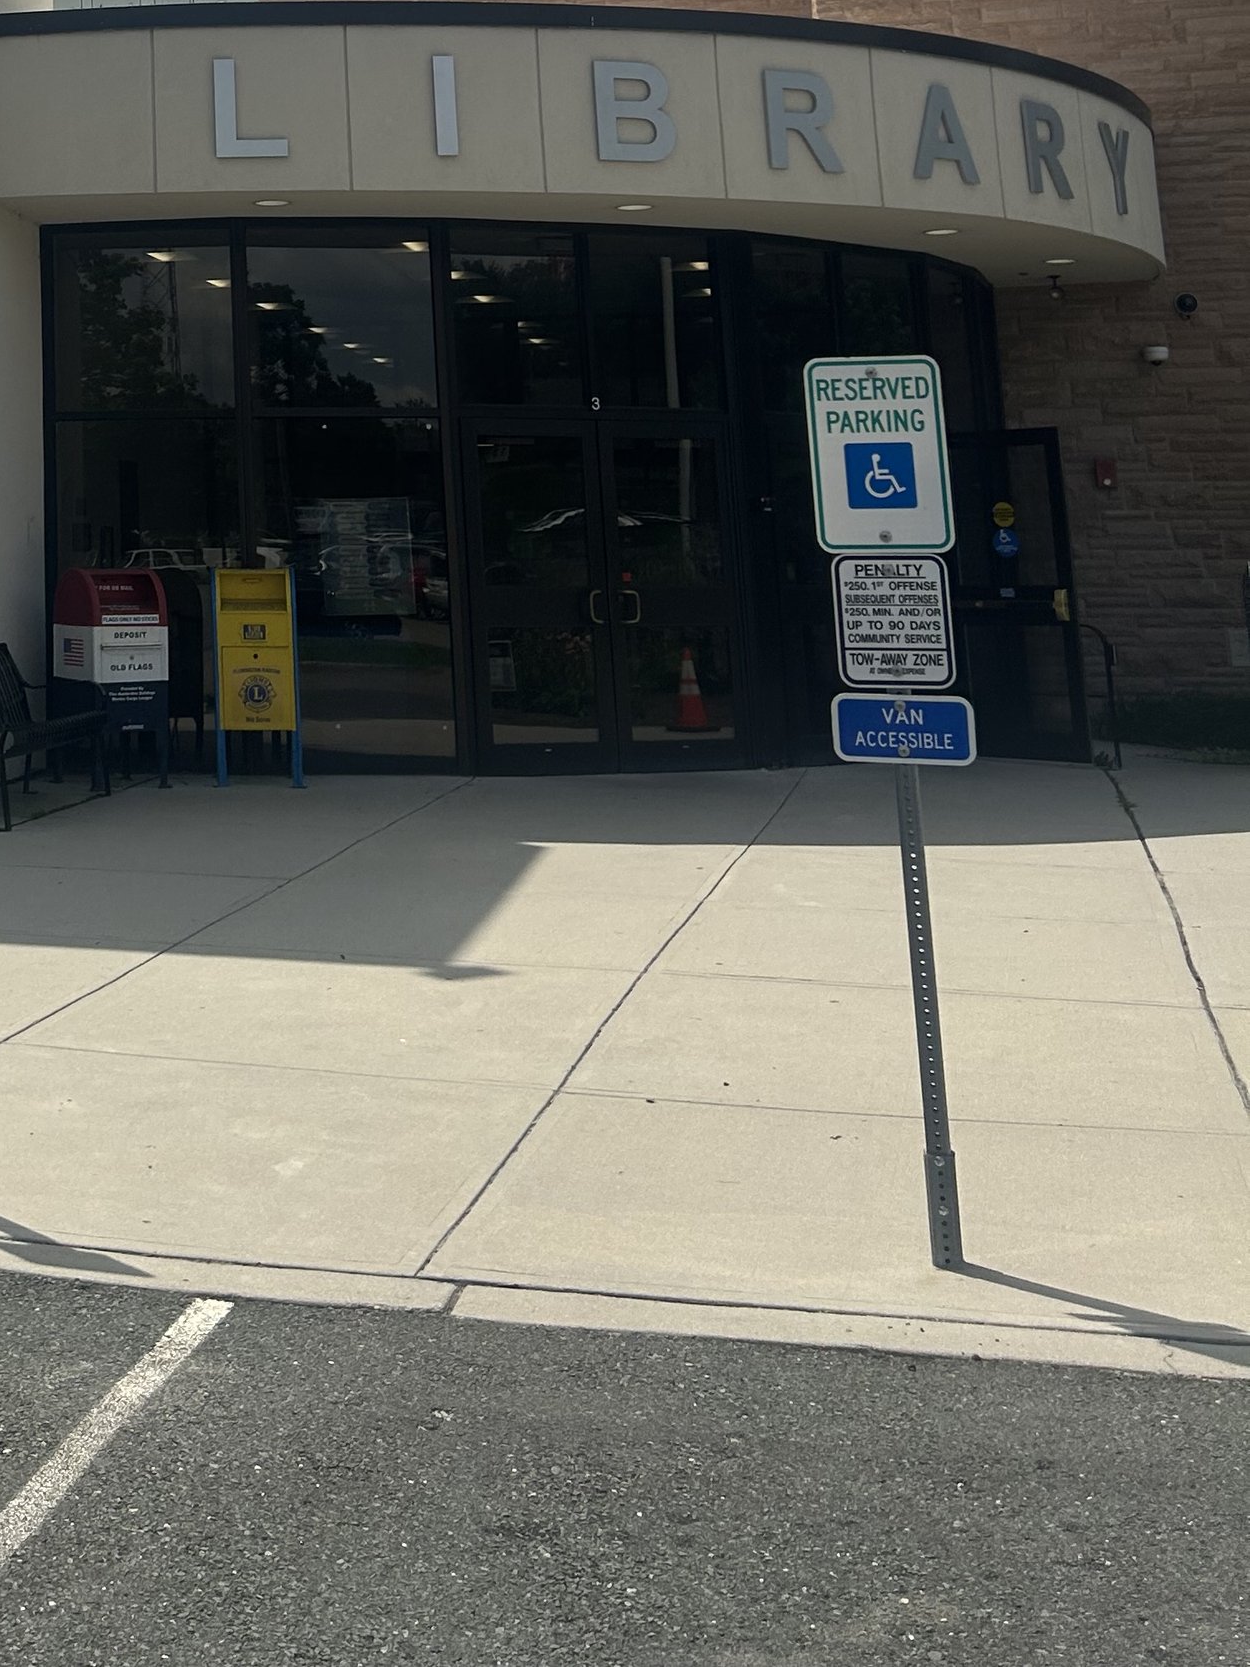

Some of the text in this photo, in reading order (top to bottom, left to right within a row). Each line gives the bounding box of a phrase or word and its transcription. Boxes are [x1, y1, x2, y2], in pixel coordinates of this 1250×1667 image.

[213, 55, 1129, 215] LIBRARY
[816, 376, 930, 401] RESERVED
[591, 396, 600, 411] 3
[826, 409, 925, 434] PARKING
[854, 564, 923, 576] PENLTY
[888, 581, 938, 591] OFFENSE
[845, 594, 939, 604] SUBSEQUENT OFFENSES
[872, 608, 894, 617] MIN.
[898, 608, 942, 617] AND/OR
[847, 620, 941, 631] UP TO 90 DAYS
[114, 631, 147, 639] DEPOSIT
[848, 633, 942, 644] COMMUNITY SERVICE
[849, 653, 944, 666] TOW-AWAY ZONE
[128, 663, 153, 671] FLAGS
[252, 686, 264, 700] L
[882, 708, 924, 725] VAN
[855, 731, 954, 750] ACCESSIBLE
